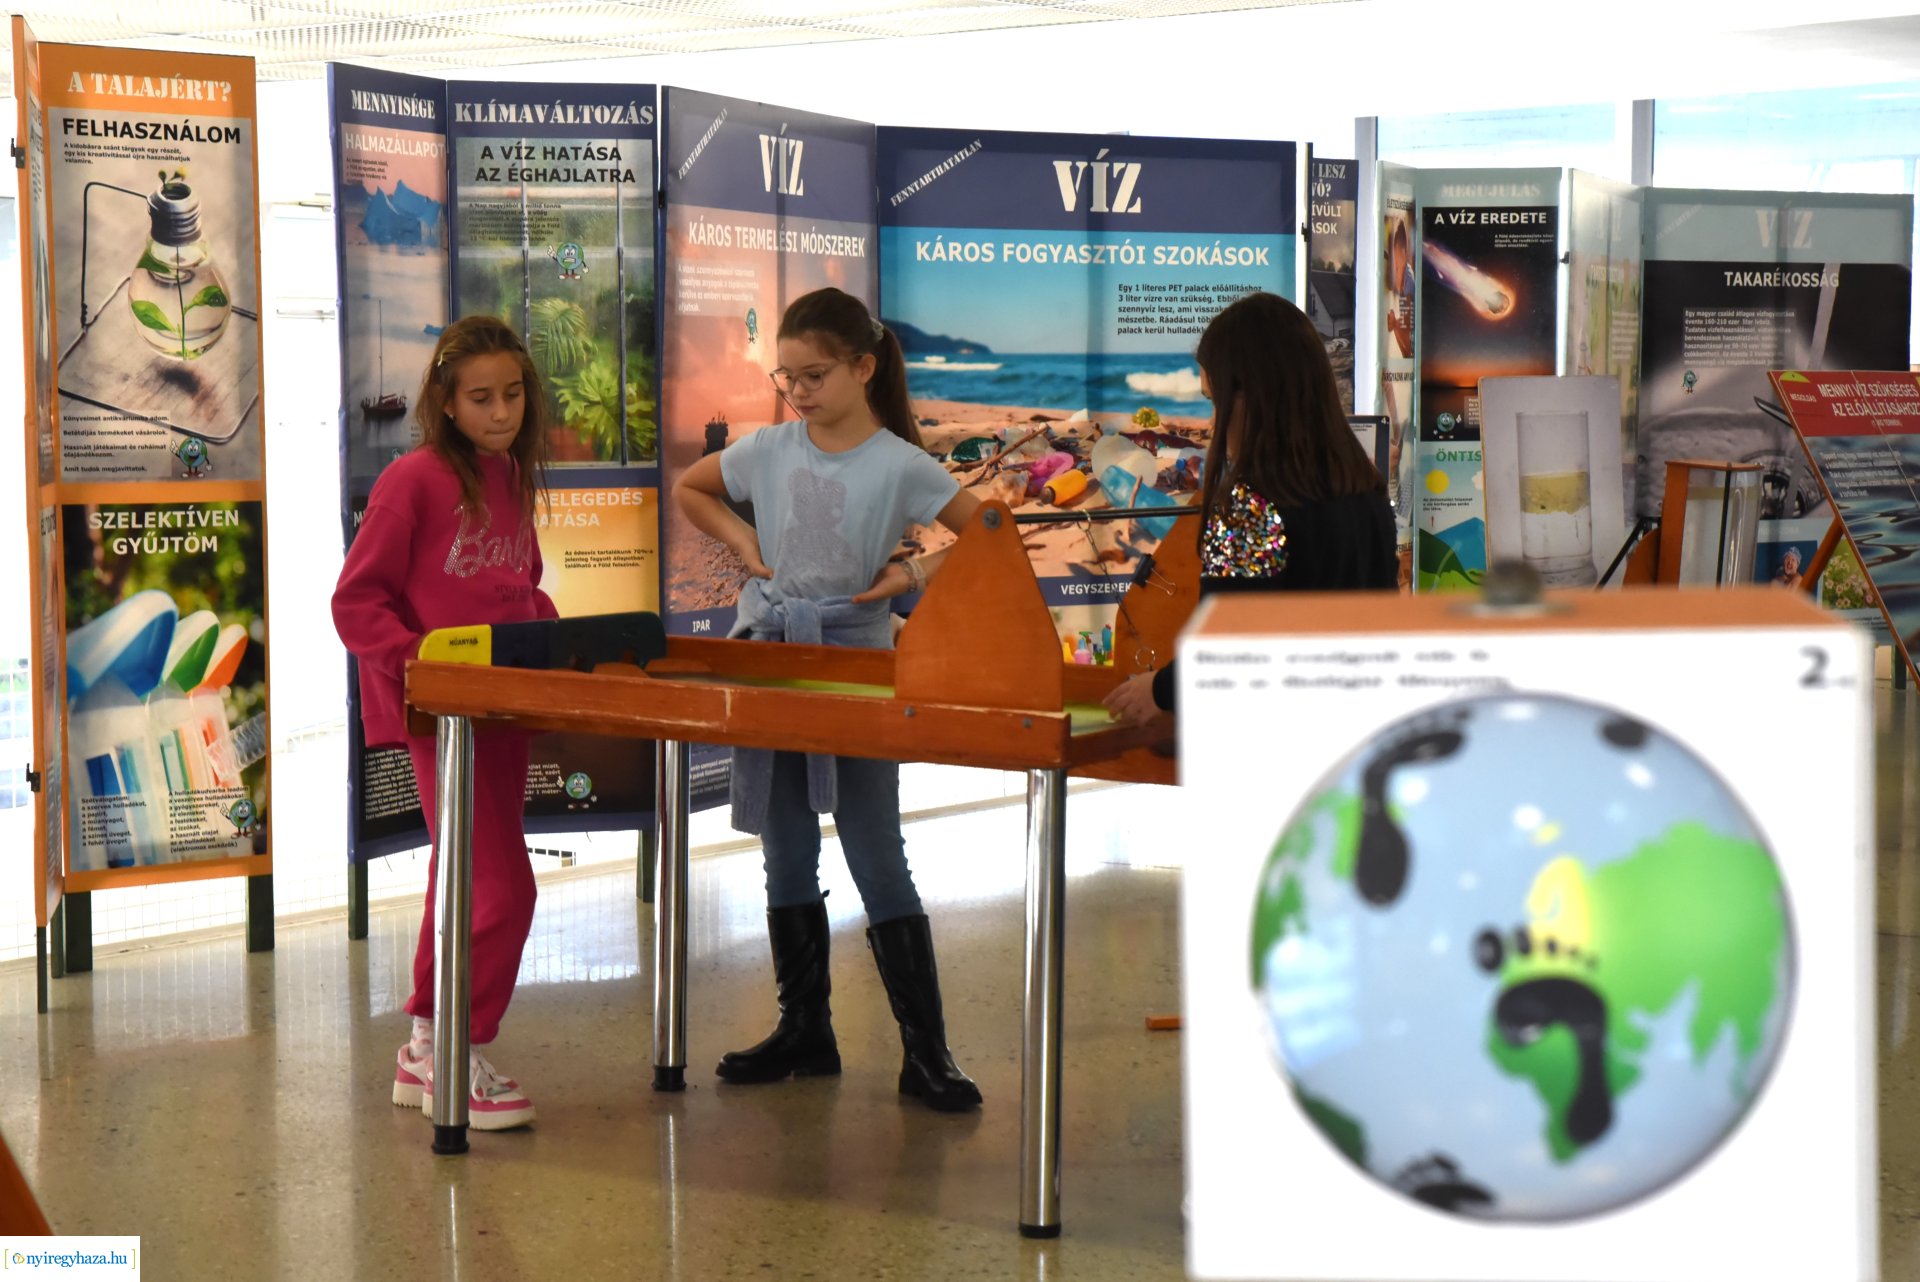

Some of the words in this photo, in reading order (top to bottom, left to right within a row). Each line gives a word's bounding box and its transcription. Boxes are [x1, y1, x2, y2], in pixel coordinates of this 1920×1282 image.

[67, 71, 84, 93] A
[91, 73, 232, 103] TALAJÉRT?
[351, 89, 435, 119] MENNYISÉGE
[455, 99, 654, 125] KLÍMAVÁLTOZÁS
[63, 118, 241, 144] FELHASZNÁLOM
[345, 132, 444, 158] HALMAZÁLLAPOT
[480, 146, 493, 160] A
[499, 142, 536, 161] VÍZ
[543, 142, 622, 161] HATÁSA
[147, 154, 190, 162] használhatjuk
[759, 122, 804, 196] VÍZ
[475, 168, 500, 182] AZ
[508, 164, 636, 183] ÉGHAJLATRA
[890, 138, 983, 207] FENNTARTHATATLAN
[1318, 163, 1346, 179] LESZ
[1052, 149, 1142, 214] VÍZ
[1435, 213, 1445, 224] A
[1449, 209, 1476, 224] VÍZ
[1480, 212, 1547, 224] EREDETE
[688, 215, 732, 248] KÁROS
[734, 223, 798, 253] TERMELÉSI
[800, 226, 866, 258] MÓDSZEREK
[916, 235, 995, 263] KÁROS
[1003, 239, 1145, 265] FOGYASZTÓI
[1153, 240, 1270, 267] SZOKÁSOK
[1724, 267, 1840, 288] TAKARÉKOSSÁG
[1118, 284, 1132, 293] Egy
[1142, 284, 1166, 292] literes
[1185, 284, 1209, 293] palack
[1212, 284, 1262, 292] előállításhoz
[1126, 294, 1141, 302] liter
[1181, 295, 1214, 304] szükség.
[1118, 305, 1155, 314] szennyvíz
[1158, 306, 1175, 314] lesz,
[1118, 316, 1156, 324] mészetbe.
[1160, 316, 1195, 324] Ráadásul
[1118, 326, 1142, 335] palack
[1145, 326, 1164, 334] kerül
[1817, 383, 1855, 398] MENNYI
[1867, 380, 1920, 398] SZÜKSÉGES
[1831, 402, 1848, 417] AZ
[89, 506, 239, 529] SZELEKTÍVEN
[112, 532, 218, 555] GYŰJTÖM
[692, 619, 711, 632] IPAR
